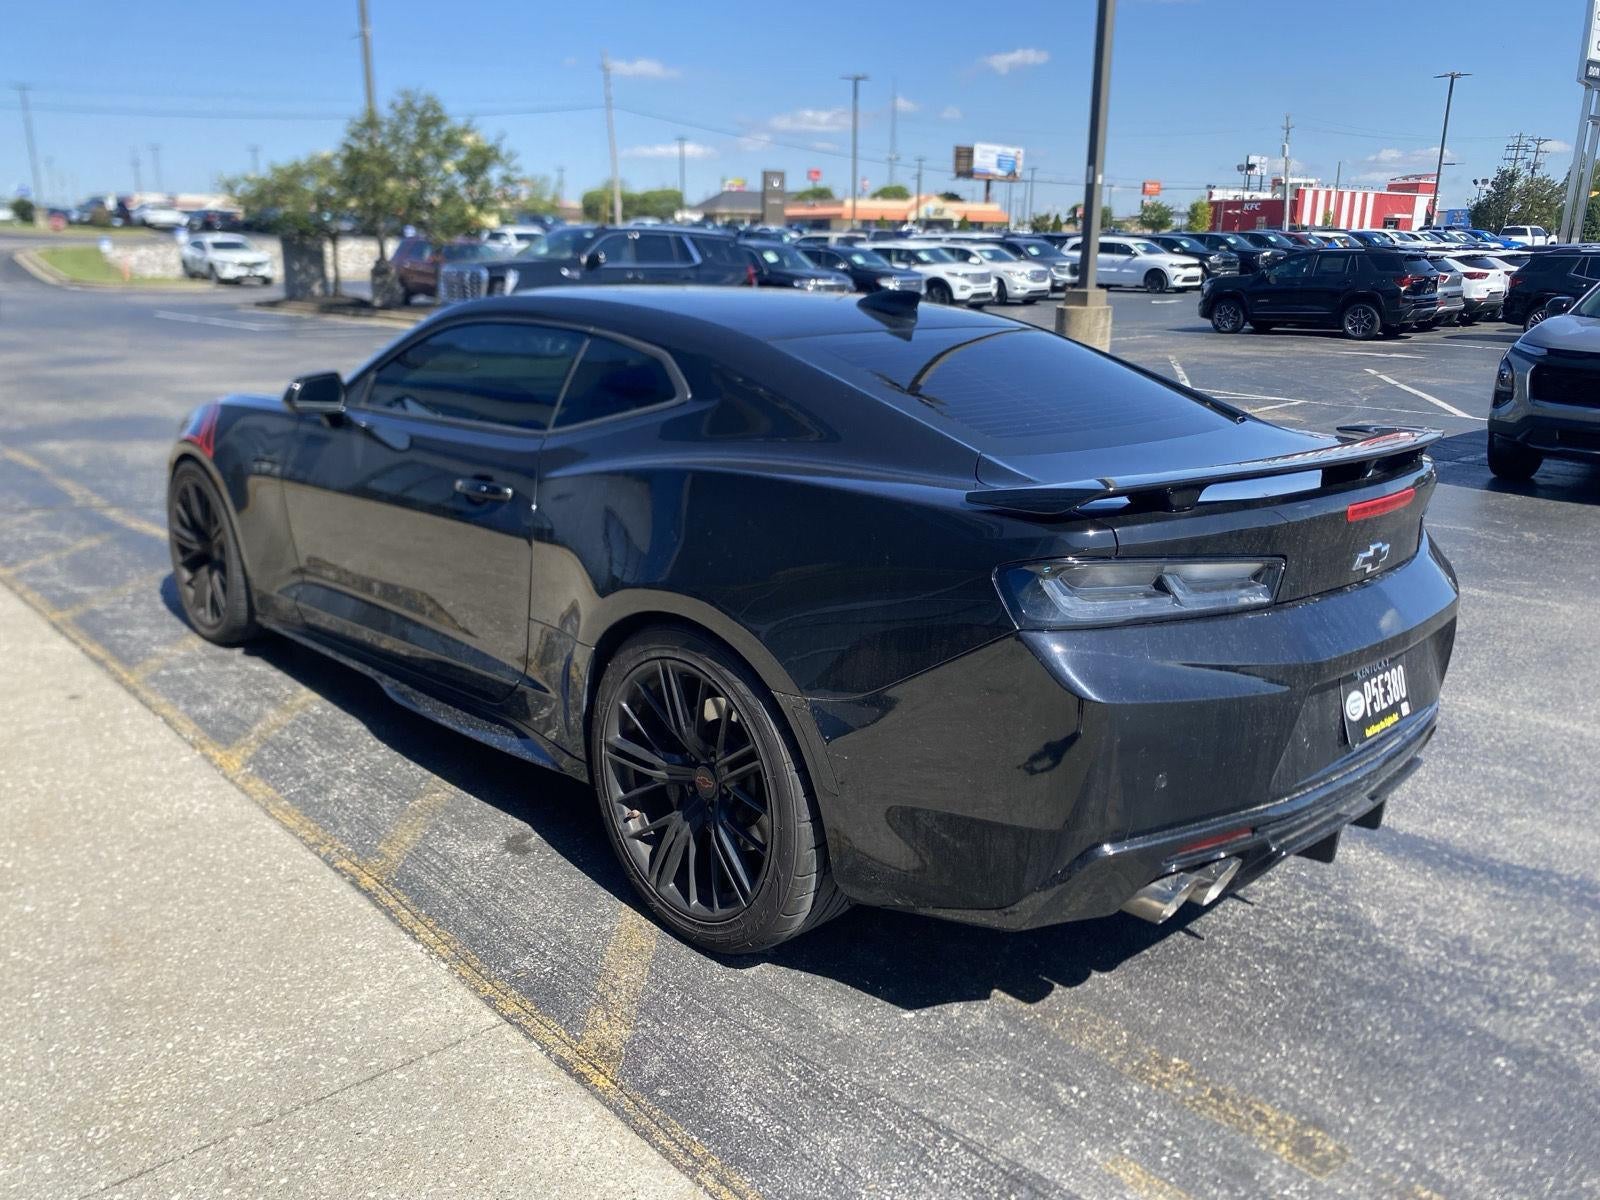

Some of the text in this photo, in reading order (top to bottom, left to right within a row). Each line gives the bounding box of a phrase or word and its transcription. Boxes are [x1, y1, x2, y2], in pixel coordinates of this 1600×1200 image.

[1244, 203, 1261, 211] KFC
[1357, 658, 1390, 681] KENTUCKY
[1363, 664, 1407, 717] P5E380
